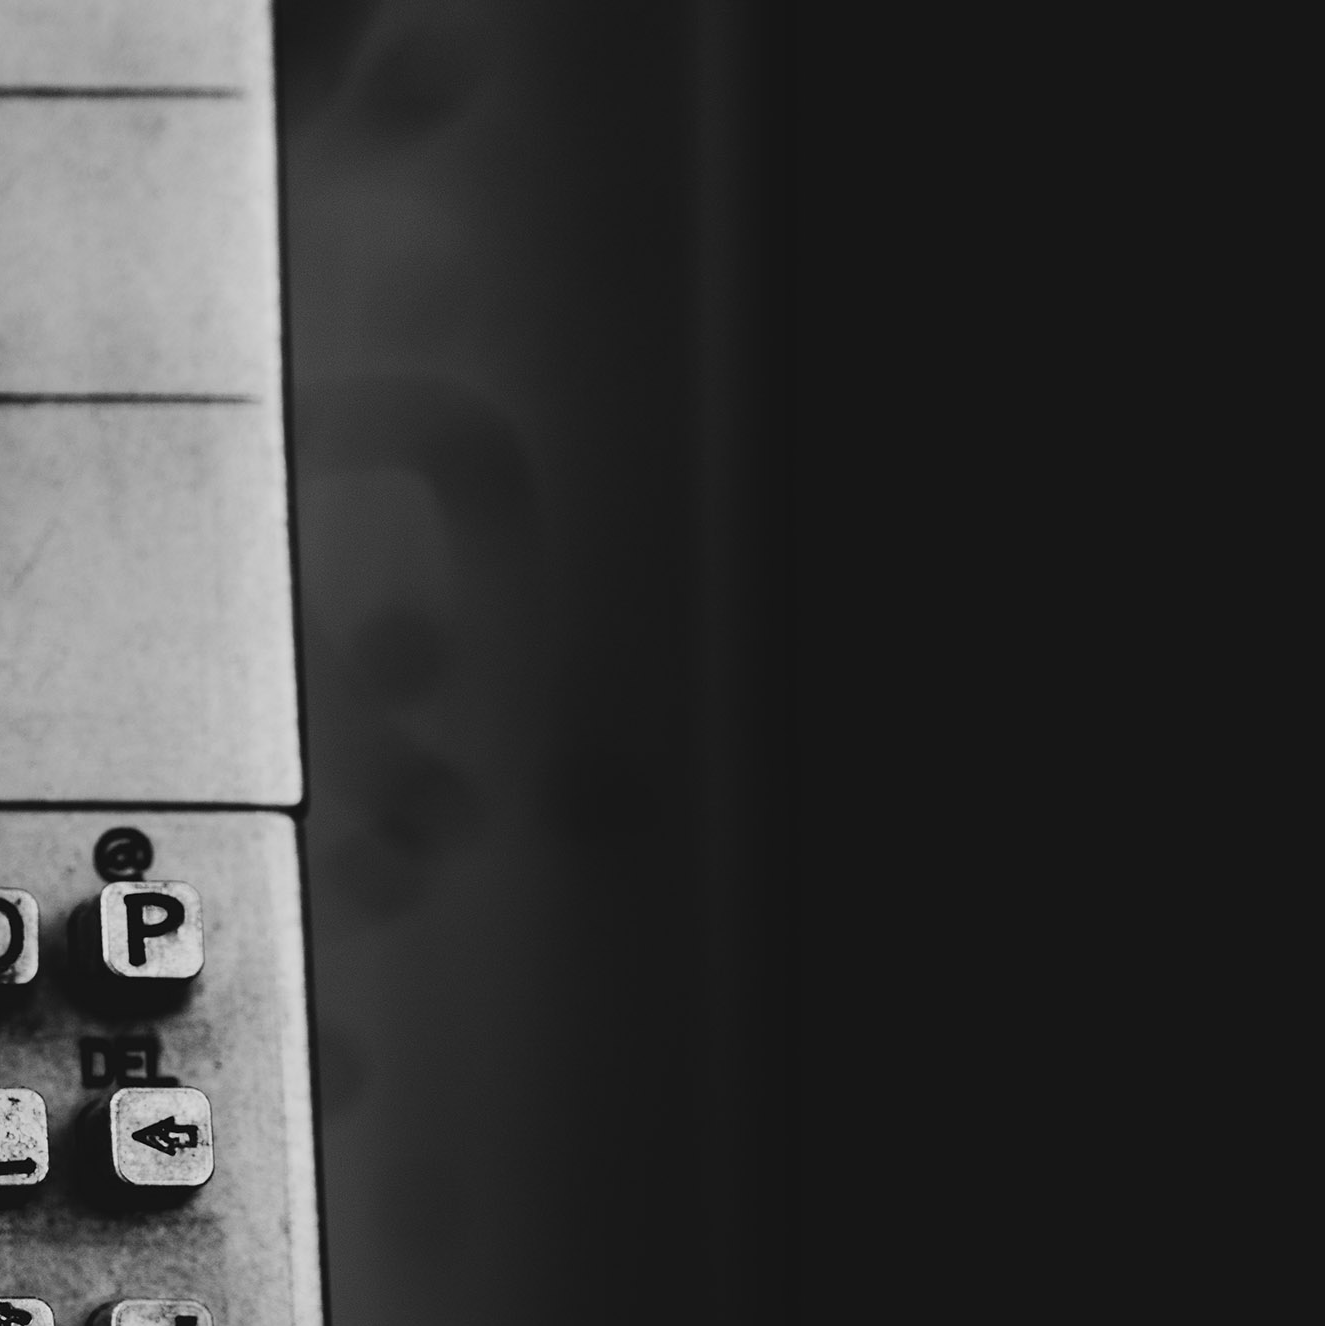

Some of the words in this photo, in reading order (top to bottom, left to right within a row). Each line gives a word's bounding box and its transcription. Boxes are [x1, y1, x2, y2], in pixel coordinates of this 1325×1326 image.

[94, 828, 154, 882] @
[124, 893, 185, 967] P
[80, 1035, 178, 1088] DEL
